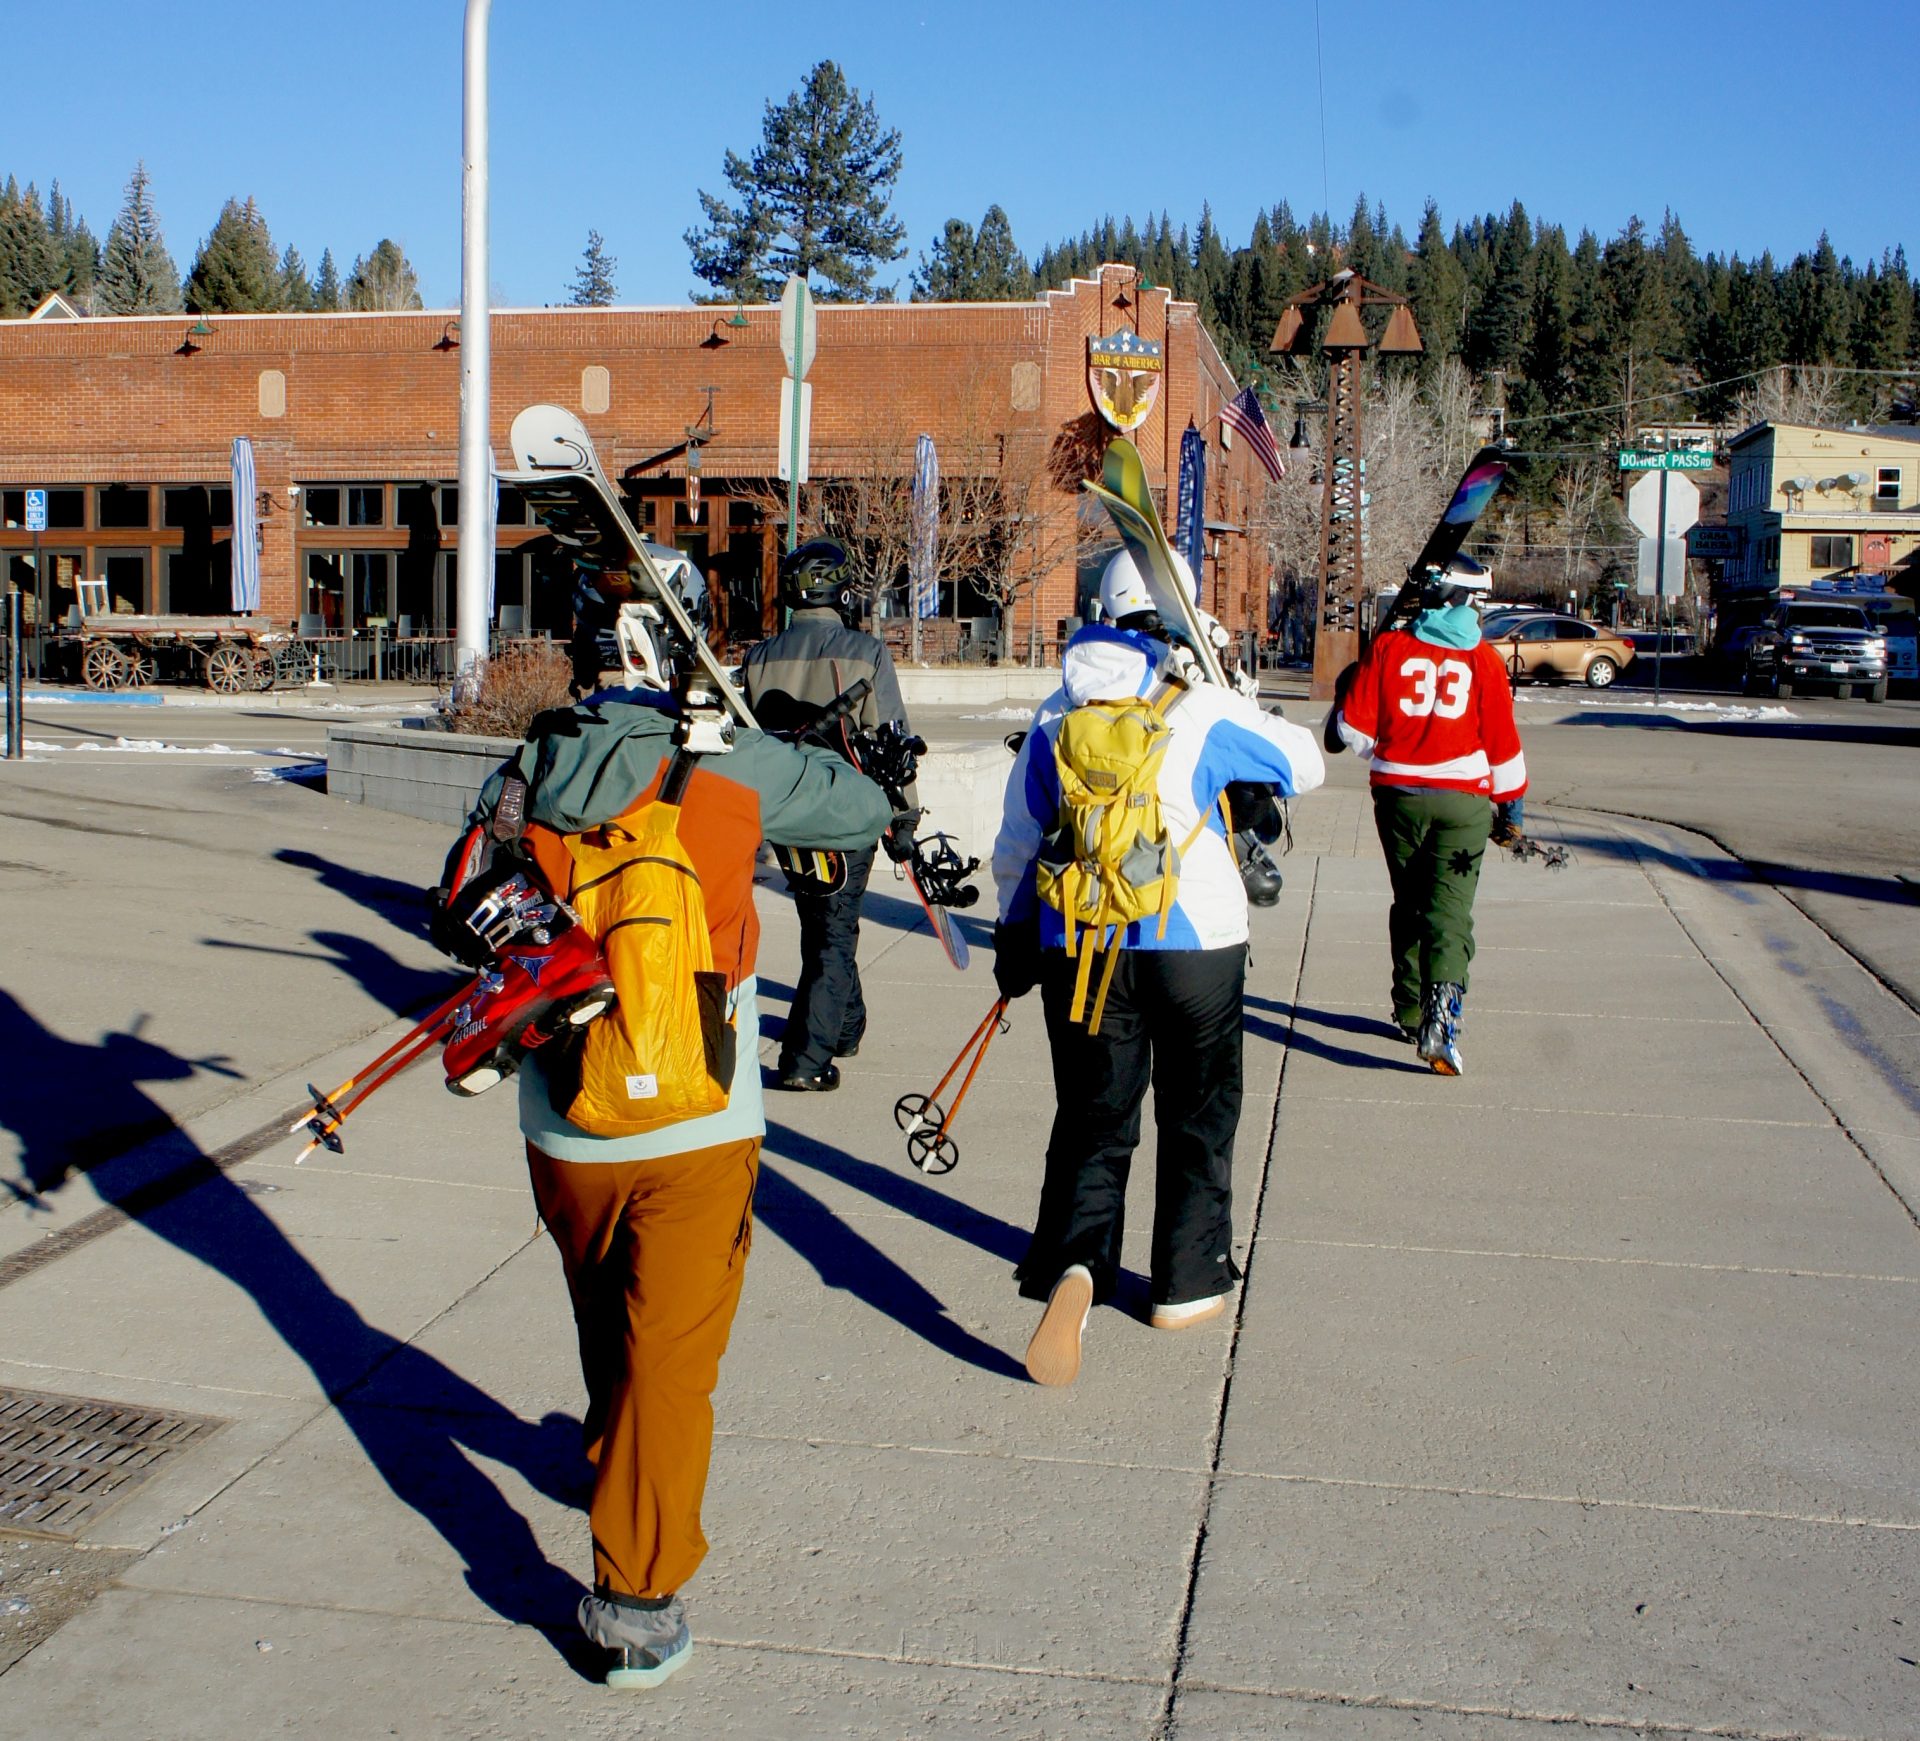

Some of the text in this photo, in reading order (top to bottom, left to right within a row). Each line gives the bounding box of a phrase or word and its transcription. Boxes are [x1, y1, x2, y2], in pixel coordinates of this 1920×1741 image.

[1093, 354, 1111, 366] BAR
[1123, 356, 1162, 370] AMERICA
[1621, 453, 1711, 467] DONNER PASS RD
[1400, 657, 1473, 720] 33
